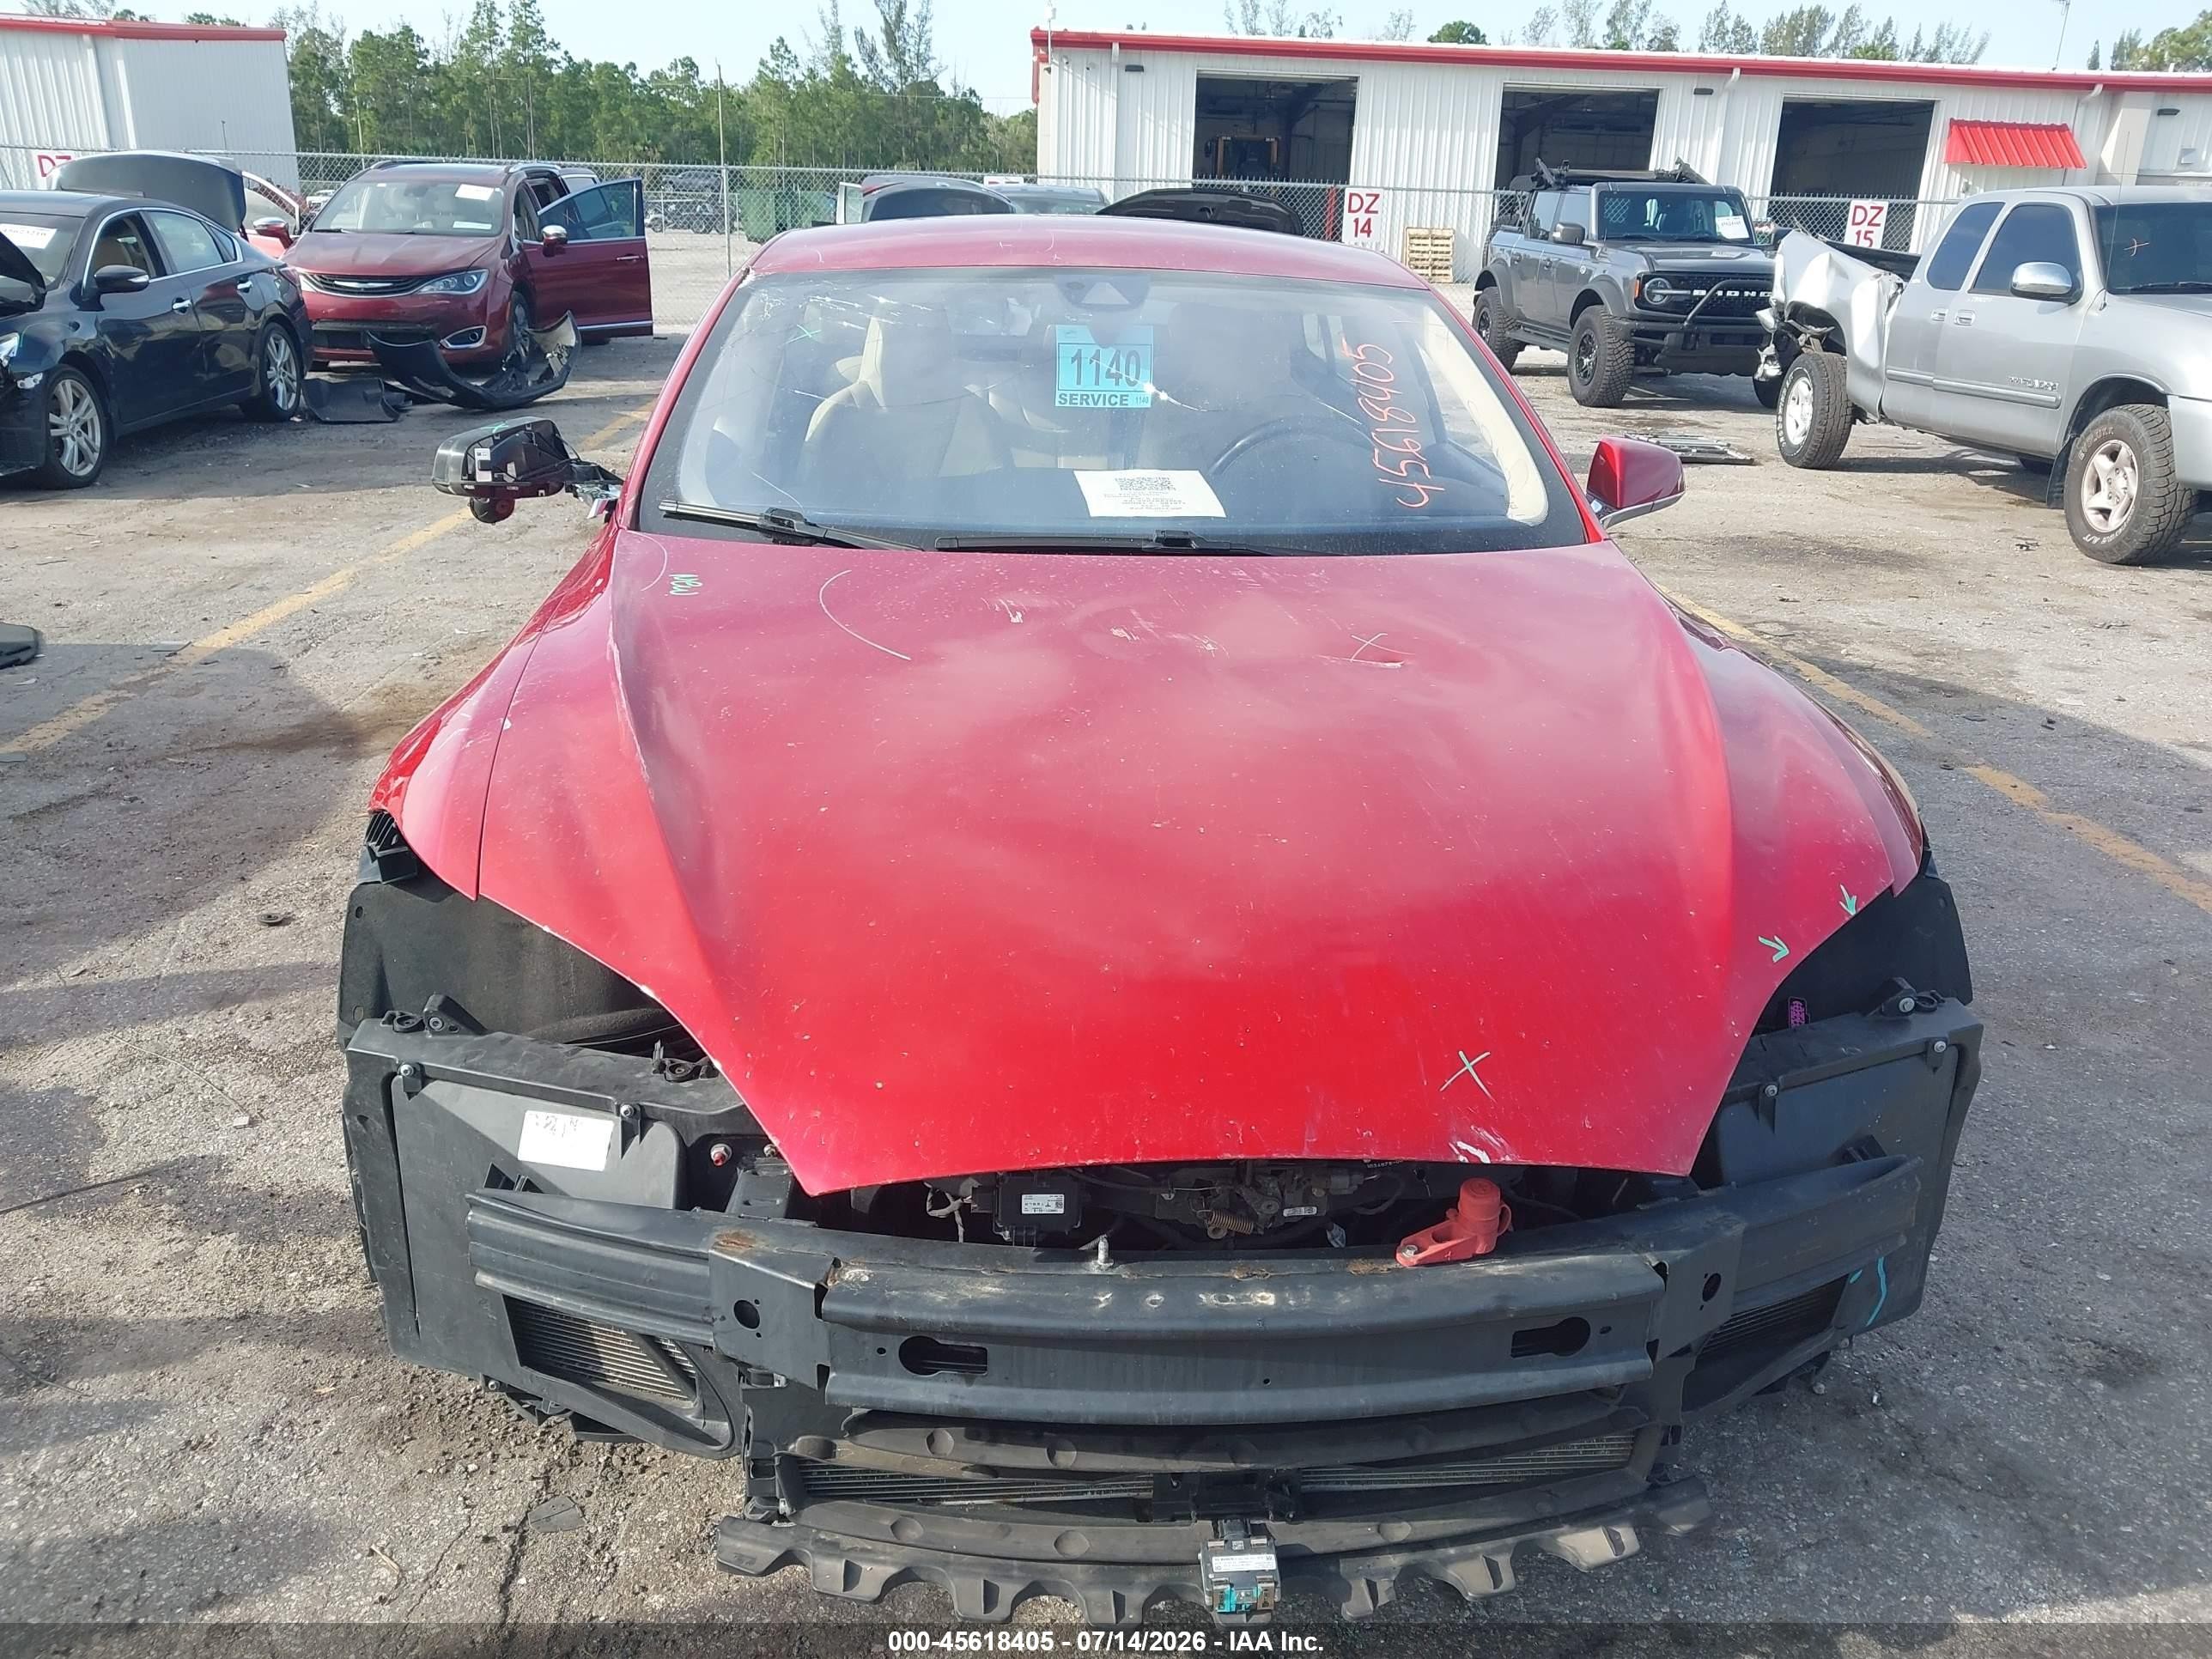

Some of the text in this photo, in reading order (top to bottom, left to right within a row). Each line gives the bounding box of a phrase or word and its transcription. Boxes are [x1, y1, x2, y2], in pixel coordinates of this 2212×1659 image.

[38, 155, 71, 177] D
[1348, 192, 1380, 214] DZ
[1852, 205, 1884, 227] DZ
[1353, 217, 1371, 238] 14
[1856, 230, 1874, 247] 15
[1071, 349, 1141, 386] 1140
[1058, 393, 1149, 406] SERVICE 1140
[1342, 337, 1445, 507] 45618405
